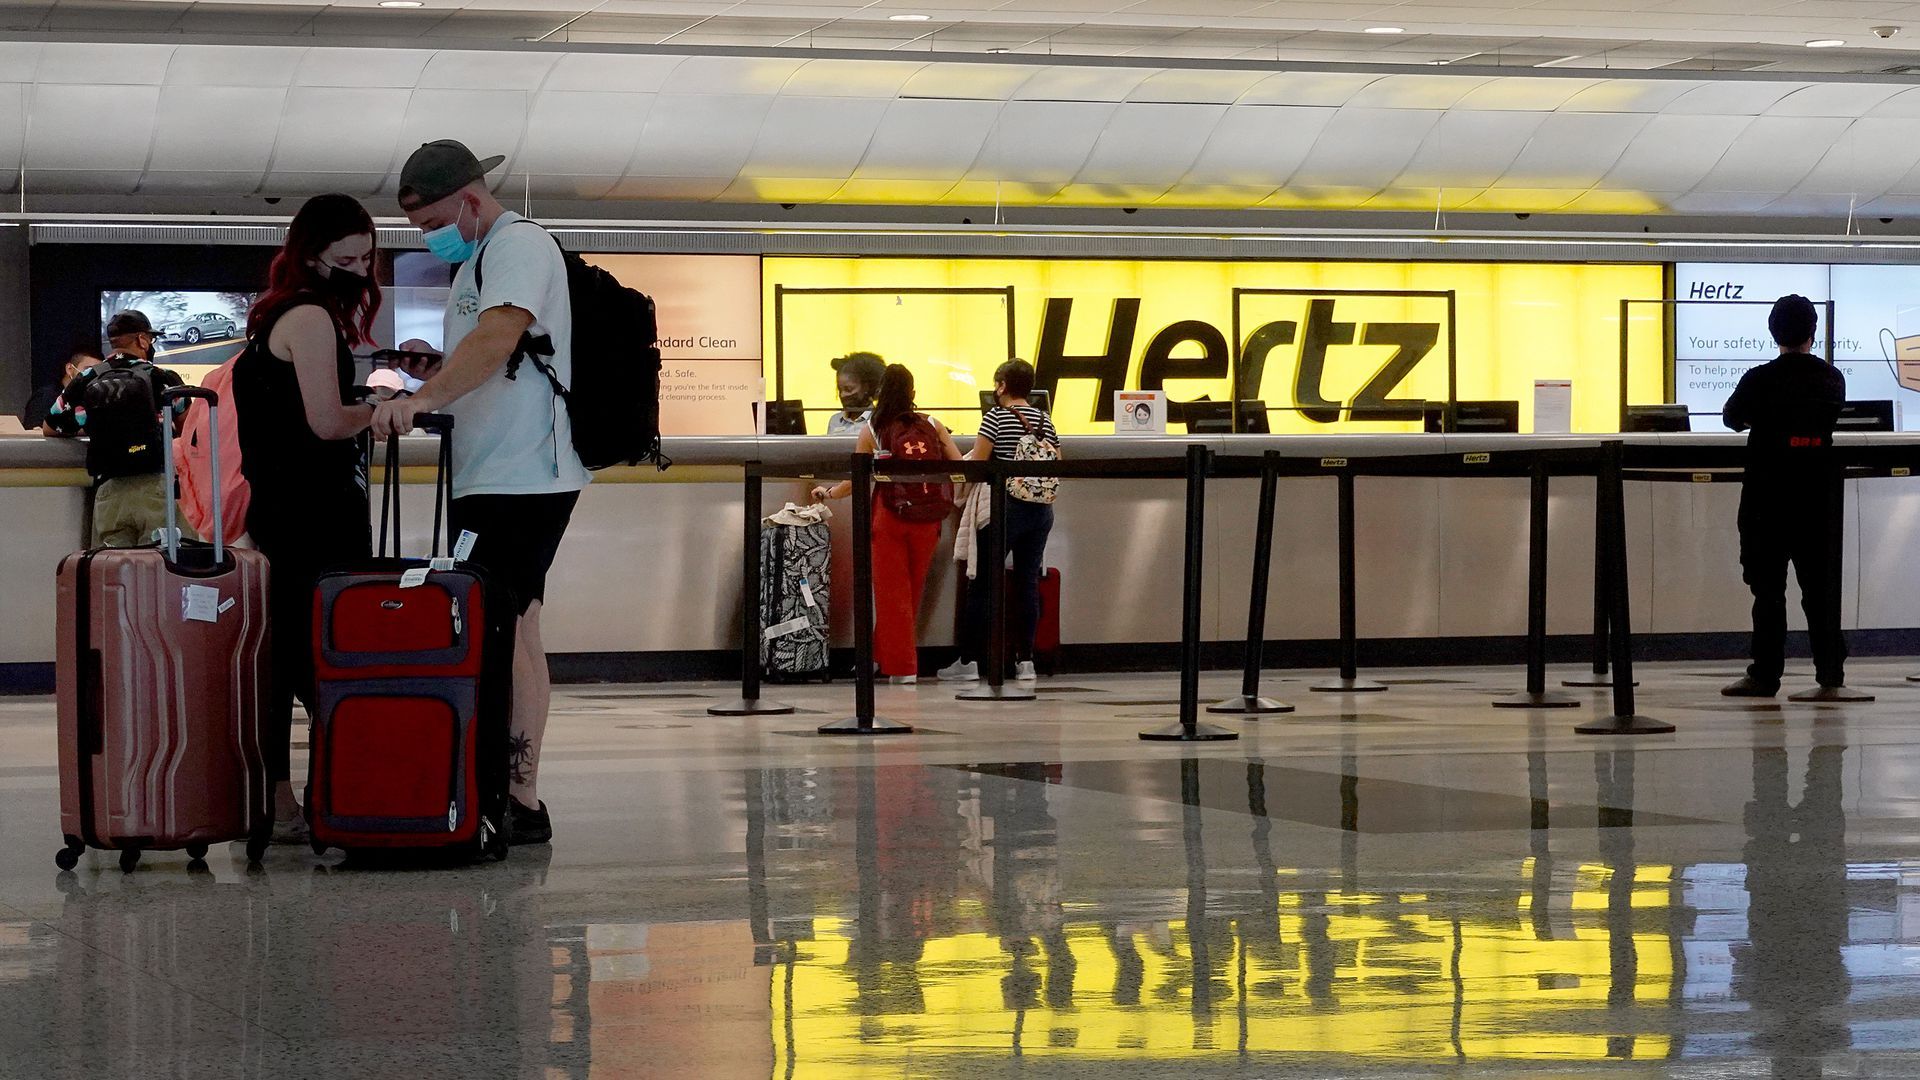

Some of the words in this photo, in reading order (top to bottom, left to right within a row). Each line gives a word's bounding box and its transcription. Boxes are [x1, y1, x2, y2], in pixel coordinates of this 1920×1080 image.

[1689, 281, 1744, 299] Hertz
[656, 336, 694, 348] ndard
[699, 336, 737, 348] Clean
[1689, 336, 1718, 349] Your
[1723, 336, 1765, 351] safety
[1030, 297, 1441, 424] Hertz
[675, 369, 697, 378] Safe.
[1688, 364, 1701, 375] To
[1704, 364, 1728, 377] help
[674, 384, 696, 392] you're
[665, 393, 696, 402] cleaning
